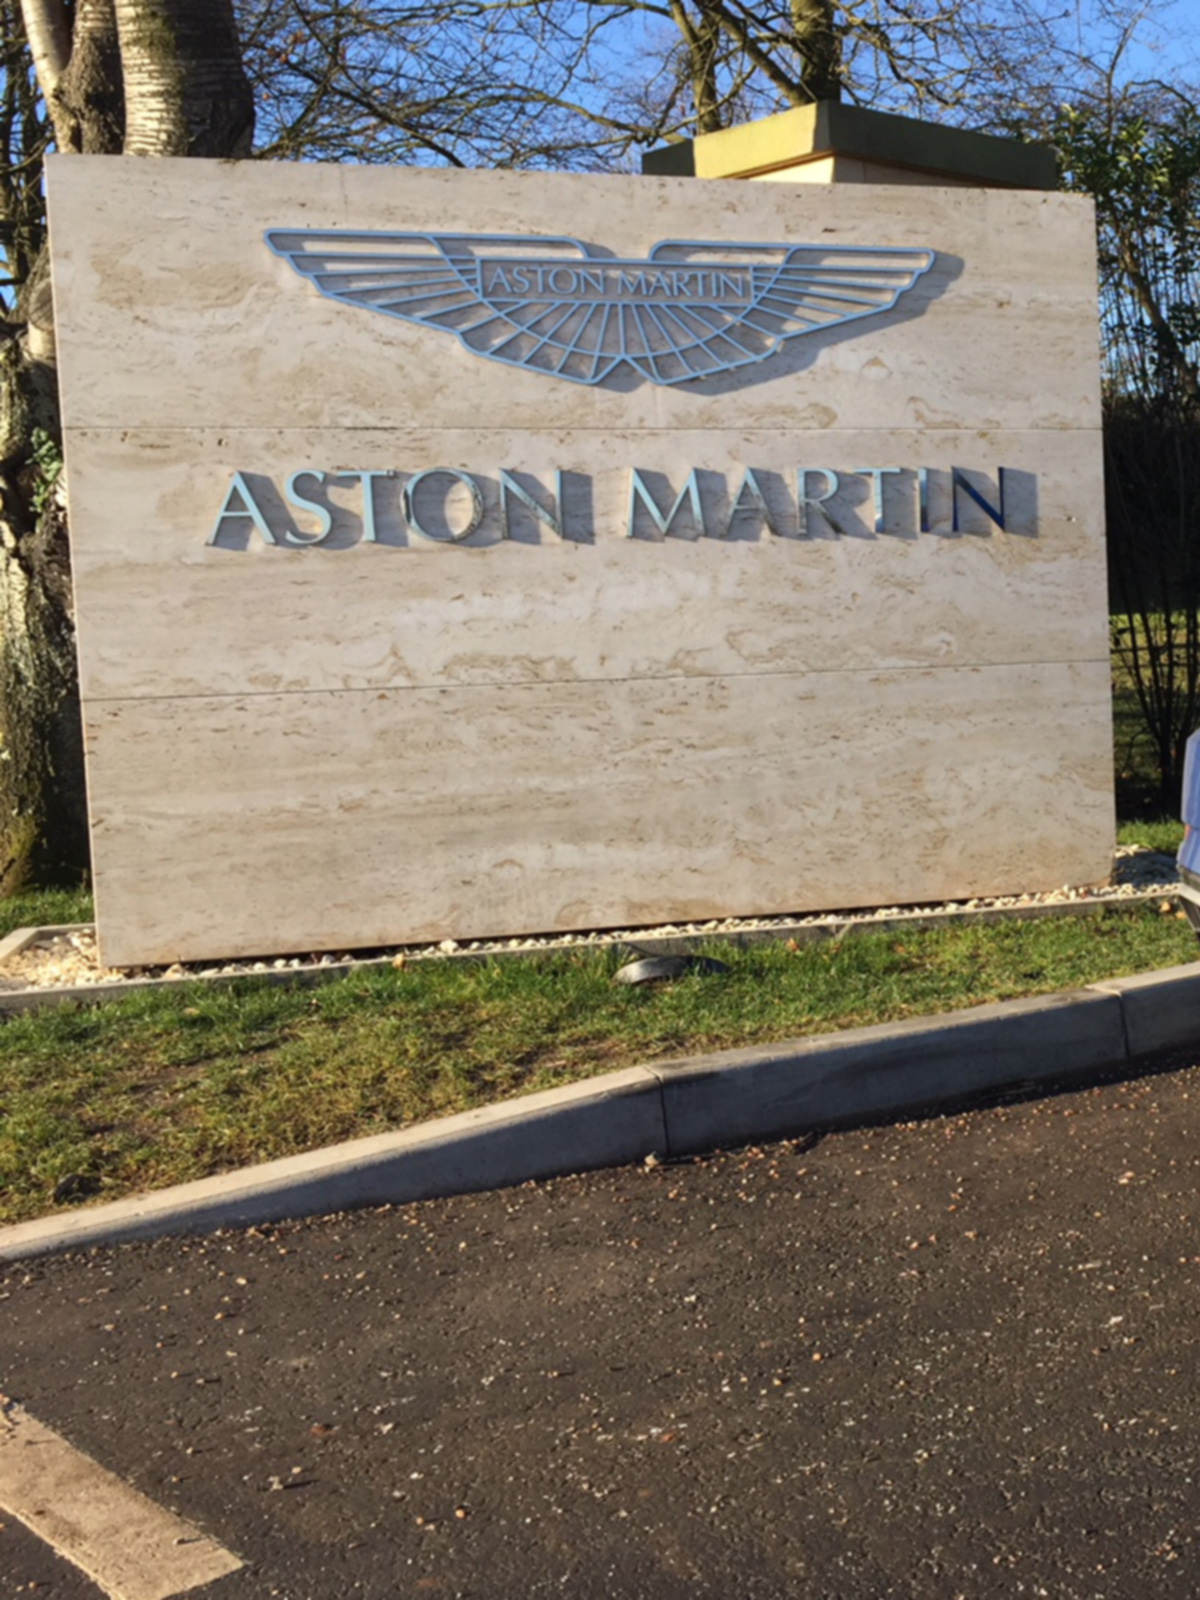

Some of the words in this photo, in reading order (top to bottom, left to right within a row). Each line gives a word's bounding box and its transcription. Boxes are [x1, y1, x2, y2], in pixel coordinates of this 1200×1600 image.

[488, 266, 605, 294] ASTON
[617, 271, 745, 298] MARTIN
[205, 468, 566, 546] ASTON
[626, 466, 1008, 539] MARTIN
